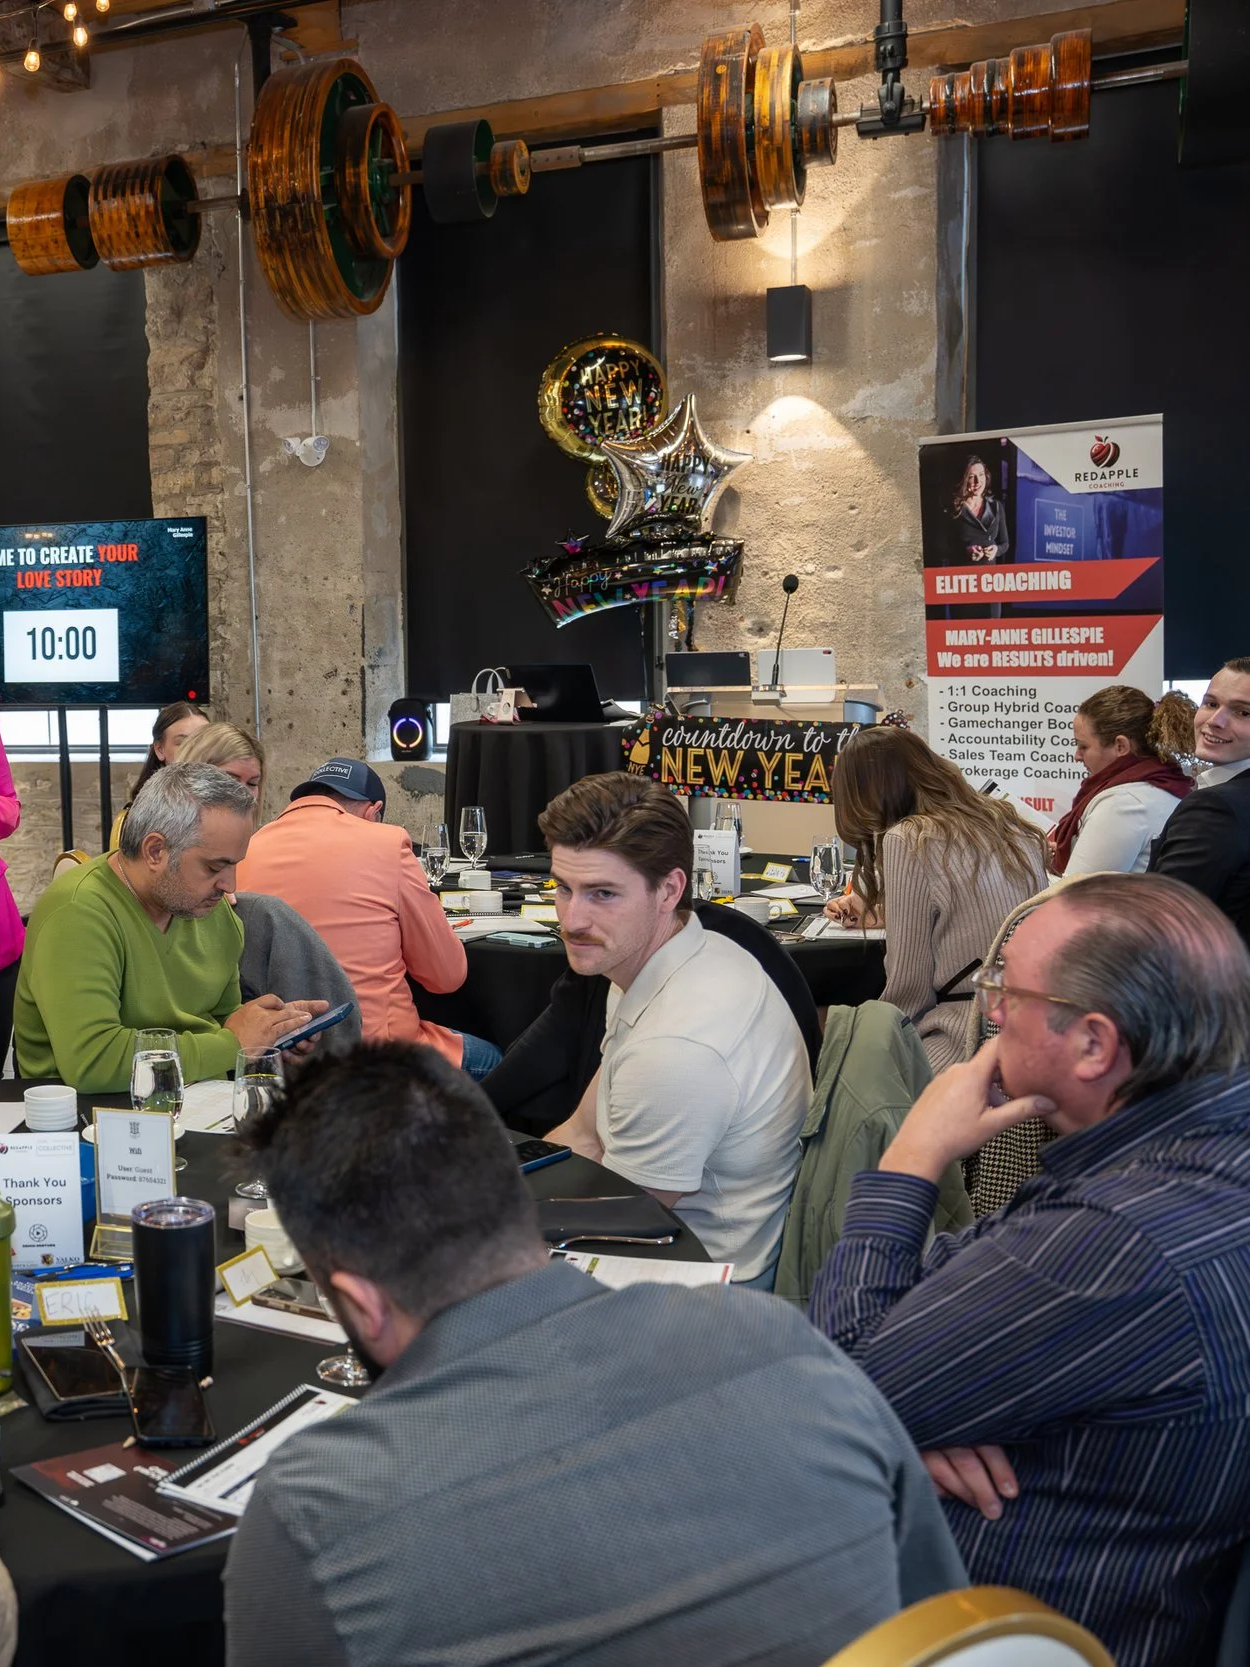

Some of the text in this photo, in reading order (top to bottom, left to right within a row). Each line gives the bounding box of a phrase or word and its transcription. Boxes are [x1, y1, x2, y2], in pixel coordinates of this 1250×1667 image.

[579, 359, 639, 386] HAPPY
[584, 378, 643, 413] NEW
[588, 405, 647, 435] YEAR!
[662, 453, 710, 474] HAPPY
[663, 474, 701, 495] New
[1088, 481, 1125, 489] COACHING
[660, 494, 698, 514] YEAR
[1054, 508, 1067, 521] THE
[1043, 524, 1077, 539] INVESTOR
[17, 548, 36, 566] TO
[40, 545, 94, 564] CREATE
[97, 544, 139, 562] YOUR
[1045, 542, 1074, 556] MINDSET
[16, 569, 103, 589] LOVE STORY
[552, 569, 612, 597] Happy
[936, 570, 1072, 594] ELITE COACHING
[551, 576, 726, 620] NEW YEAR!
[26, 626, 96, 660] 10:00
[945, 627, 1104, 646] MARY-ANNE GILLESPIE
[937, 650, 1114, 668] We are RESULTS driven!
[947, 685, 1037, 699] 1:1 Coaching
[948, 701, 990, 715] Group
[994, 701, 1040, 715] Hybrid
[948, 717, 1043, 732] Gamechanger
[661, 722, 795, 751] countdown
[803, 726, 832, 753] to
[948, 733, 1046, 748] Accountability
[949, 749, 1076, 763] Sales Team Coach
[627, 762, 647, 777] NYE
[661, 747, 838, 792] NEW YEA
[960, 765, 1090, 780] rokerage Coaching
[1020, 797, 1054, 812] SULT
[3, 1177, 67, 1188] Thank You
[5, 1196, 62, 1208] Sponsors
